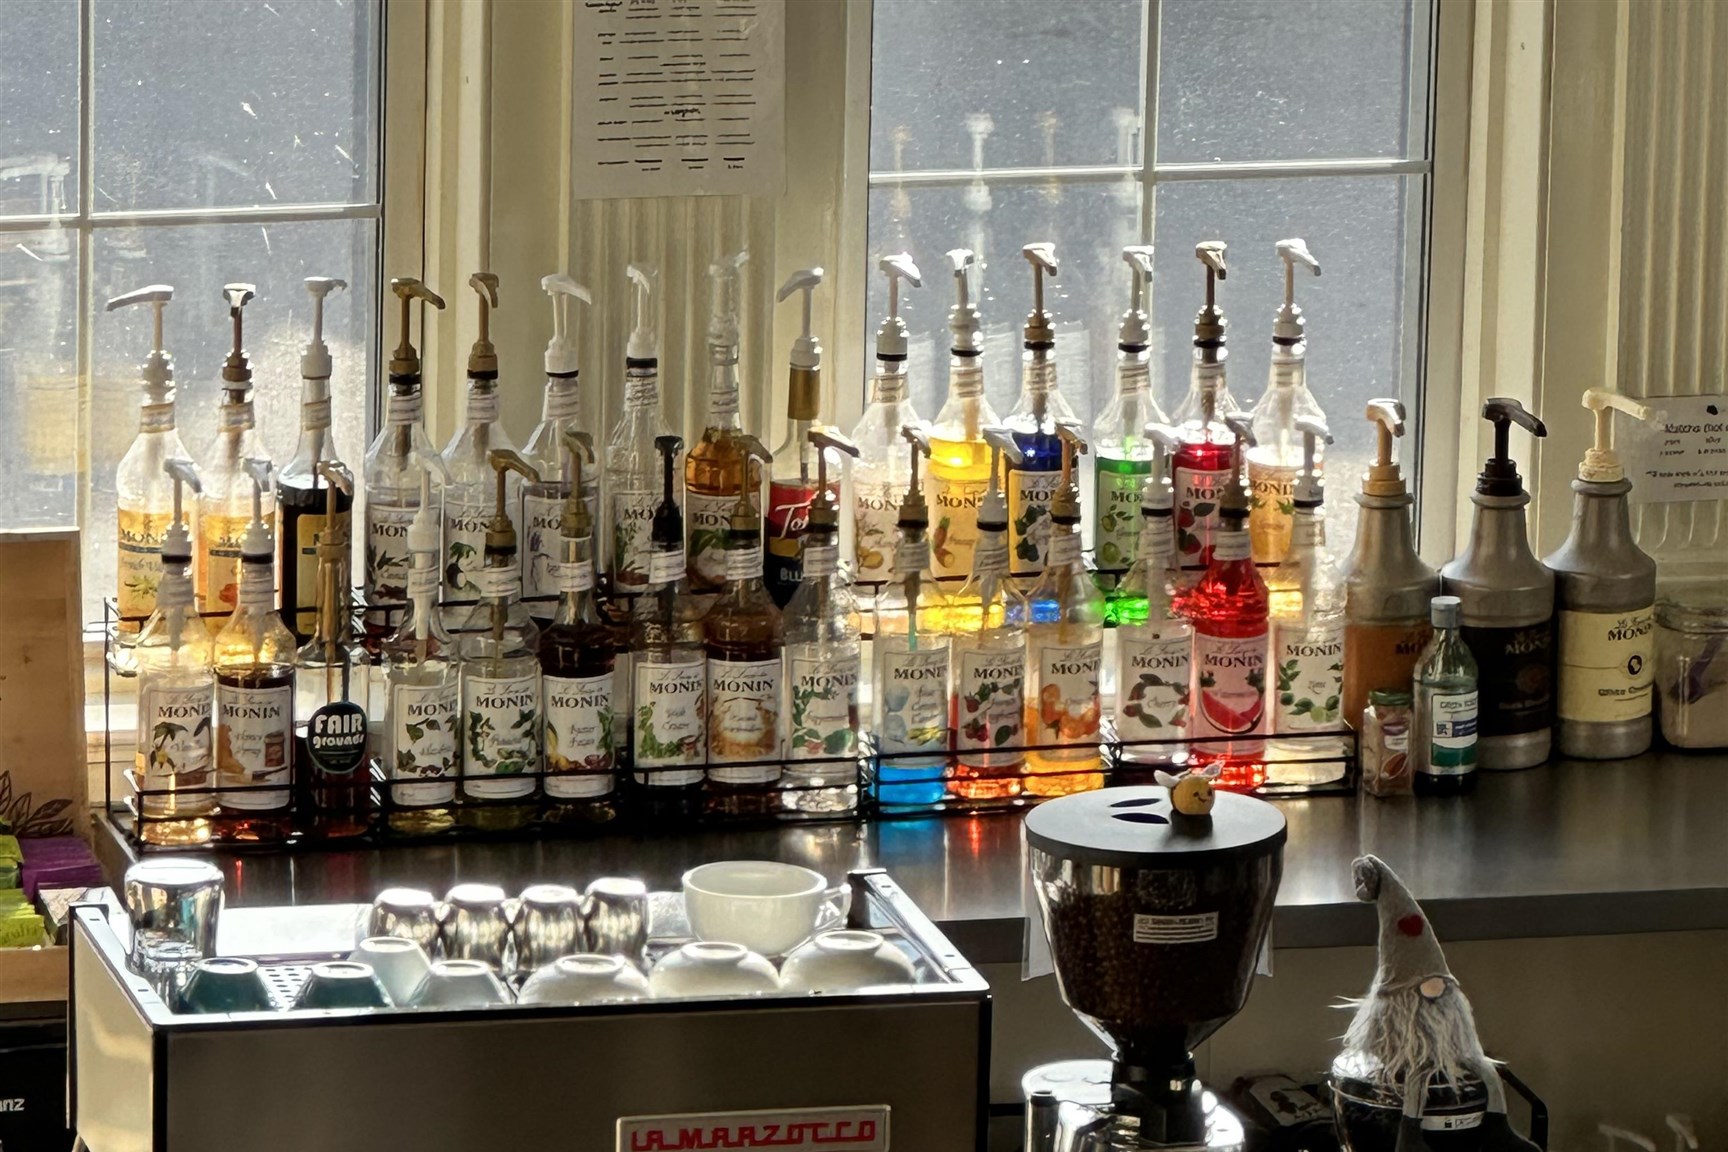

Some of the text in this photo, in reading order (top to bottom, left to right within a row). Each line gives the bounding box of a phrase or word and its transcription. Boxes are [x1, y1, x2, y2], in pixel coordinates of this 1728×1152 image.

[451, 518, 490, 533] MON
[693, 513, 730, 526] MON
[372, 523, 407, 537] MON
[1286, 643, 1341, 657] MONIN
[1204, 653, 1263, 668] MONIN
[713, 679, 773, 692] MONIN
[223, 704, 280, 719] MONIN
[315, 713, 363, 735] FAIR
[312, 734, 364, 749] grounds
[0, 1098, 25, 1112] nz
